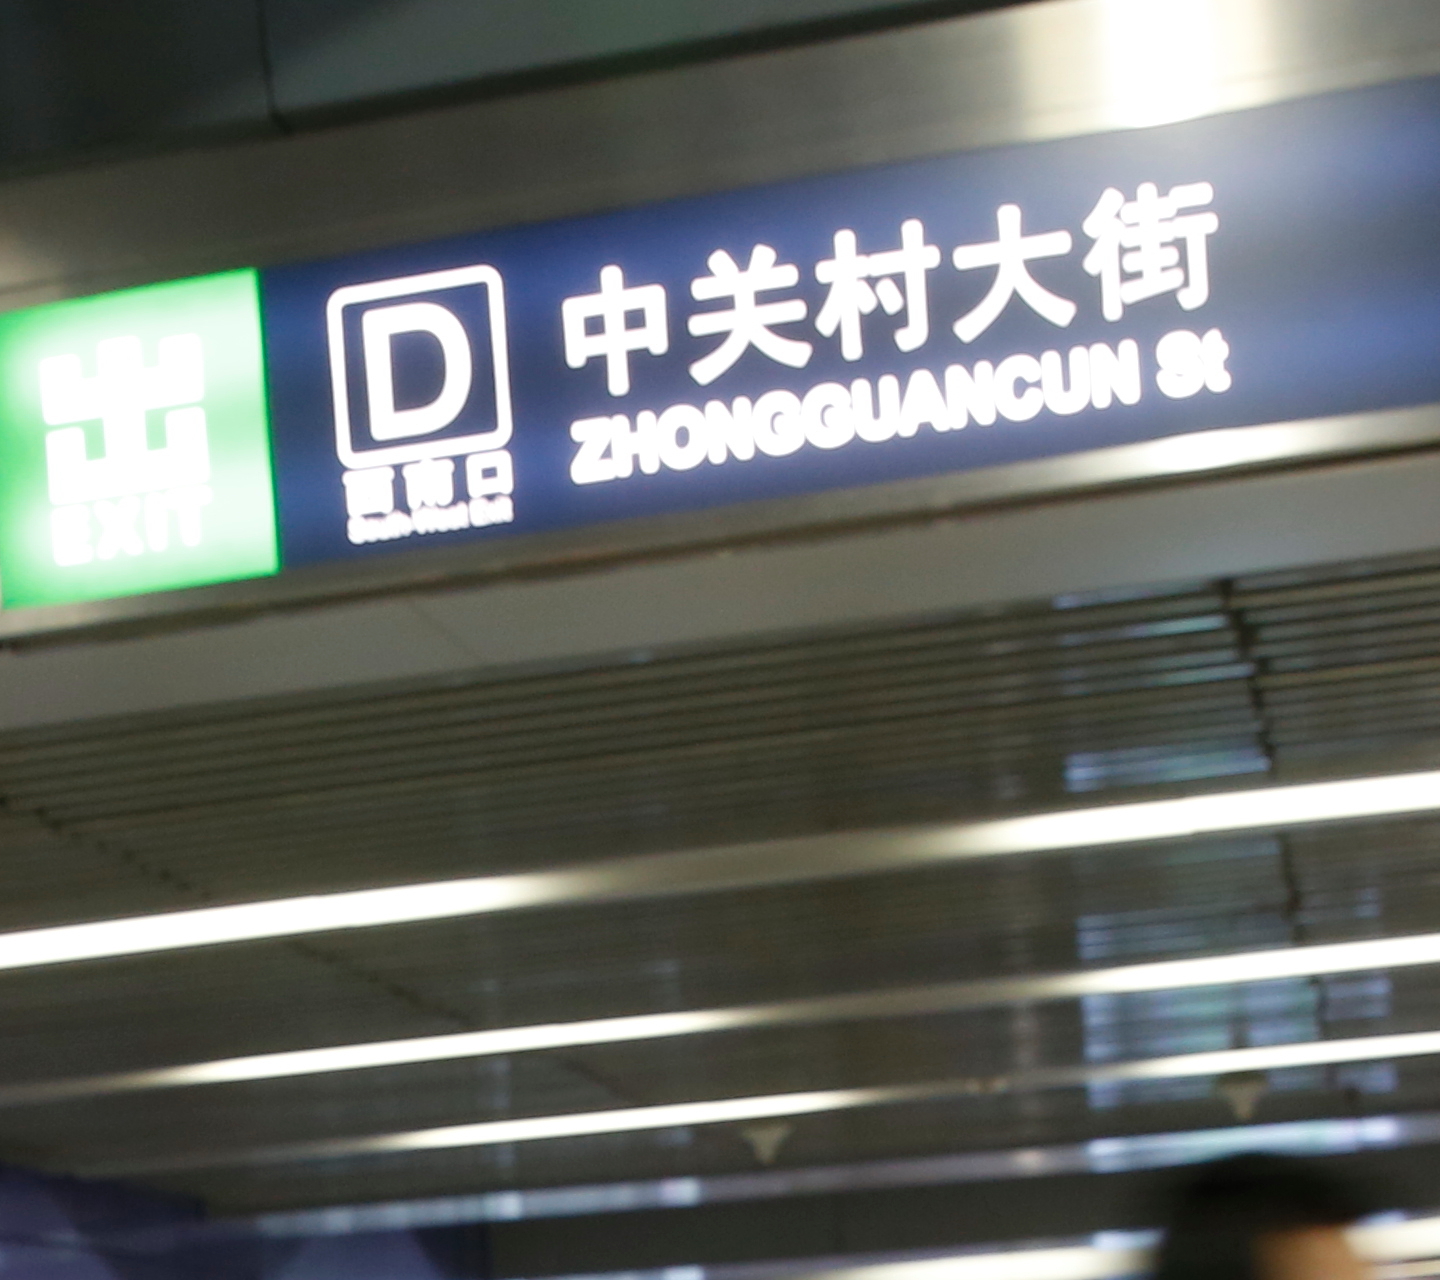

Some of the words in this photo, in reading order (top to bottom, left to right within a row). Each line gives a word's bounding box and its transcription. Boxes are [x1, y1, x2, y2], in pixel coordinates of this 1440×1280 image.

[561, 182, 1219, 397] 中关村大街
[38, 332, 211, 507] 出
[362, 302, 473, 441] D
[569, 338, 1140, 485] ZHONGGUANCUN
[1155, 327, 1232, 400] St
[49, 484, 214, 567] EXIT
